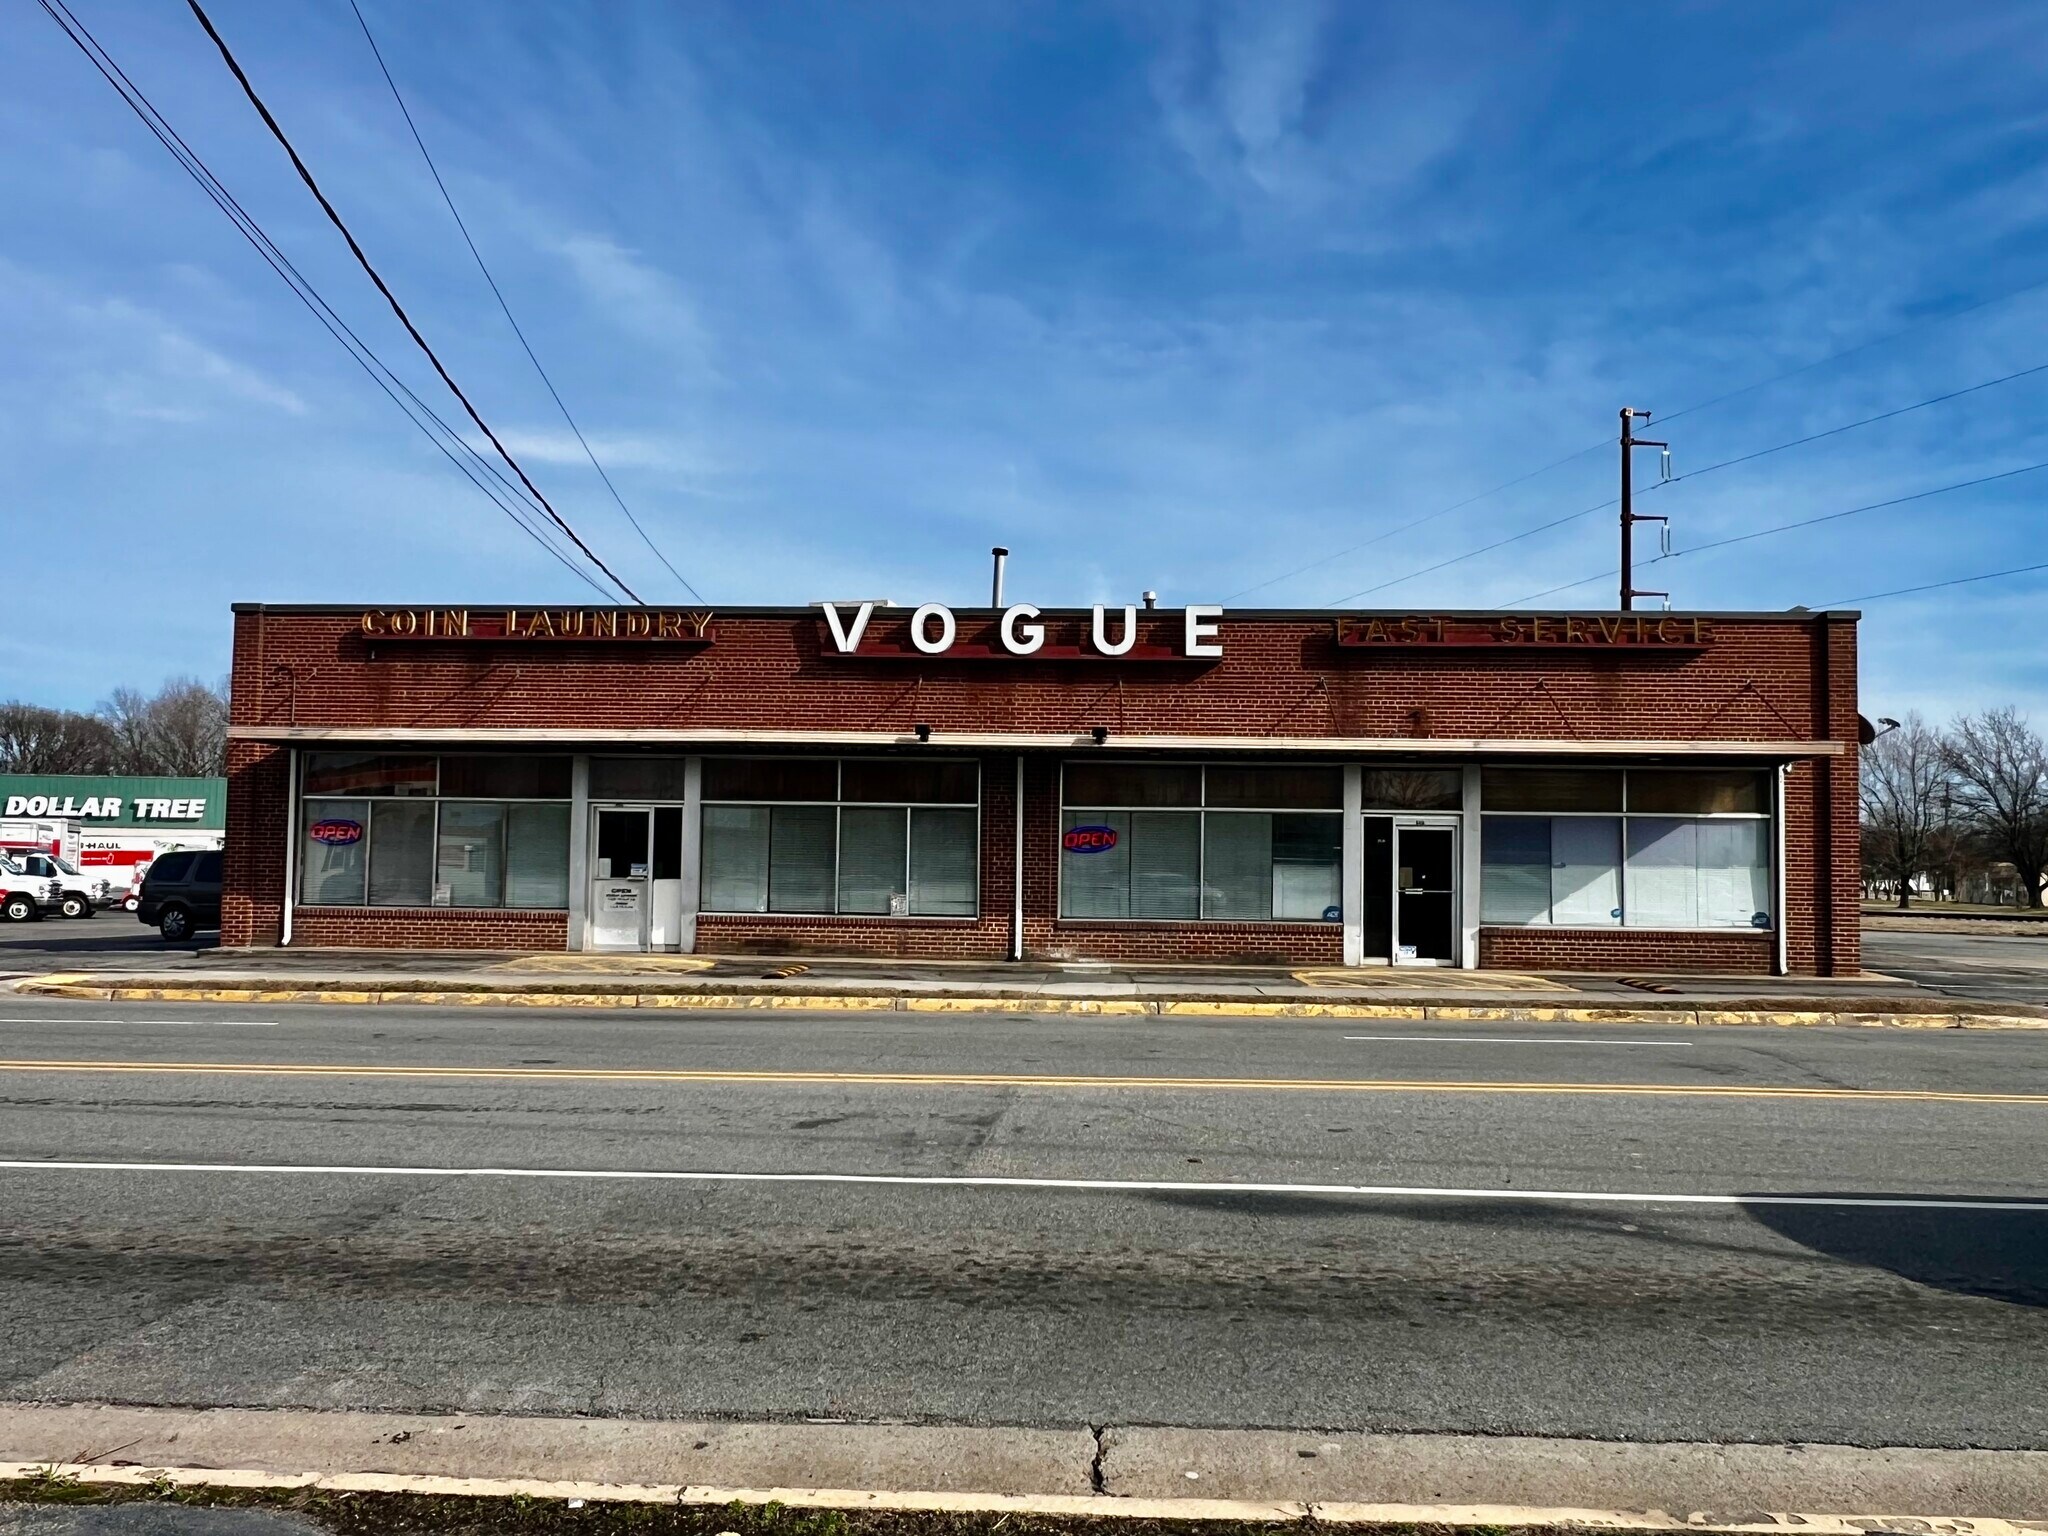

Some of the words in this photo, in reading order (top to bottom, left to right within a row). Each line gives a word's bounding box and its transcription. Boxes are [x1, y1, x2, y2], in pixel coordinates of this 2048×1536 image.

[361, 609, 468, 636] COIN
[505, 610, 714, 637] LAUNDRY
[822, 602, 1223, 656] VOGUE
[1337, 615, 1455, 643] FAST
[1499, 616, 1717, 644] SERVICE
[5, 796, 122, 817] DOLLAR
[133, 798, 207, 818] TREE
[310, 825, 361, 840] OPEN
[1064, 832, 1116, 847] OPEN
